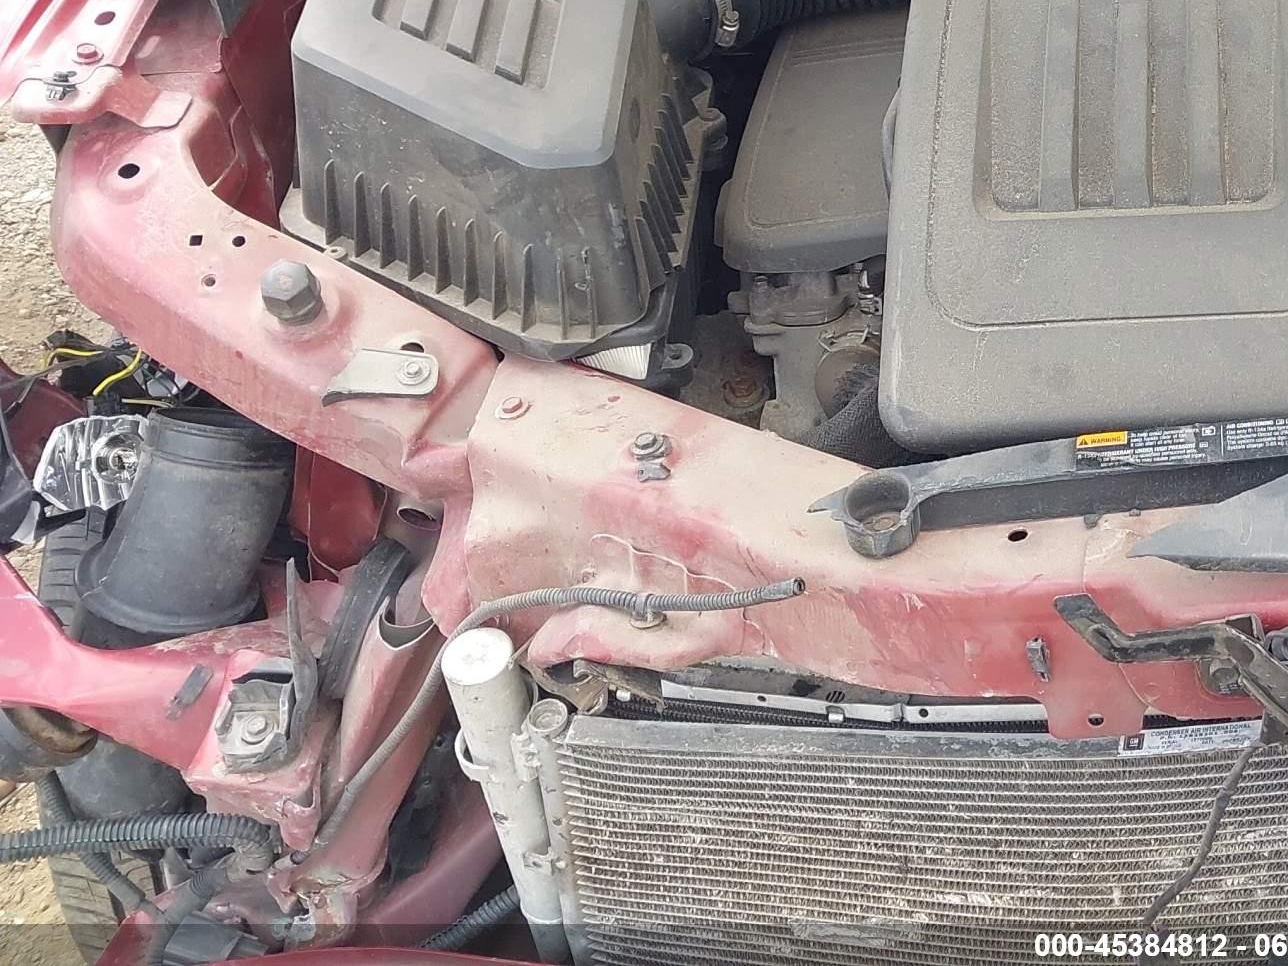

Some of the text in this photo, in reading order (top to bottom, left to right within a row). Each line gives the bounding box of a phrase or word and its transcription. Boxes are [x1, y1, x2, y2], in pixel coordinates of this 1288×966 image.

[1090, 436, 1121, 444] WARNING
[1150, 728, 1190, 737] CONDENSER
[1202, 723, 1251, 733] INTERNATIONAL
[1129, 737, 1139, 745] GM
